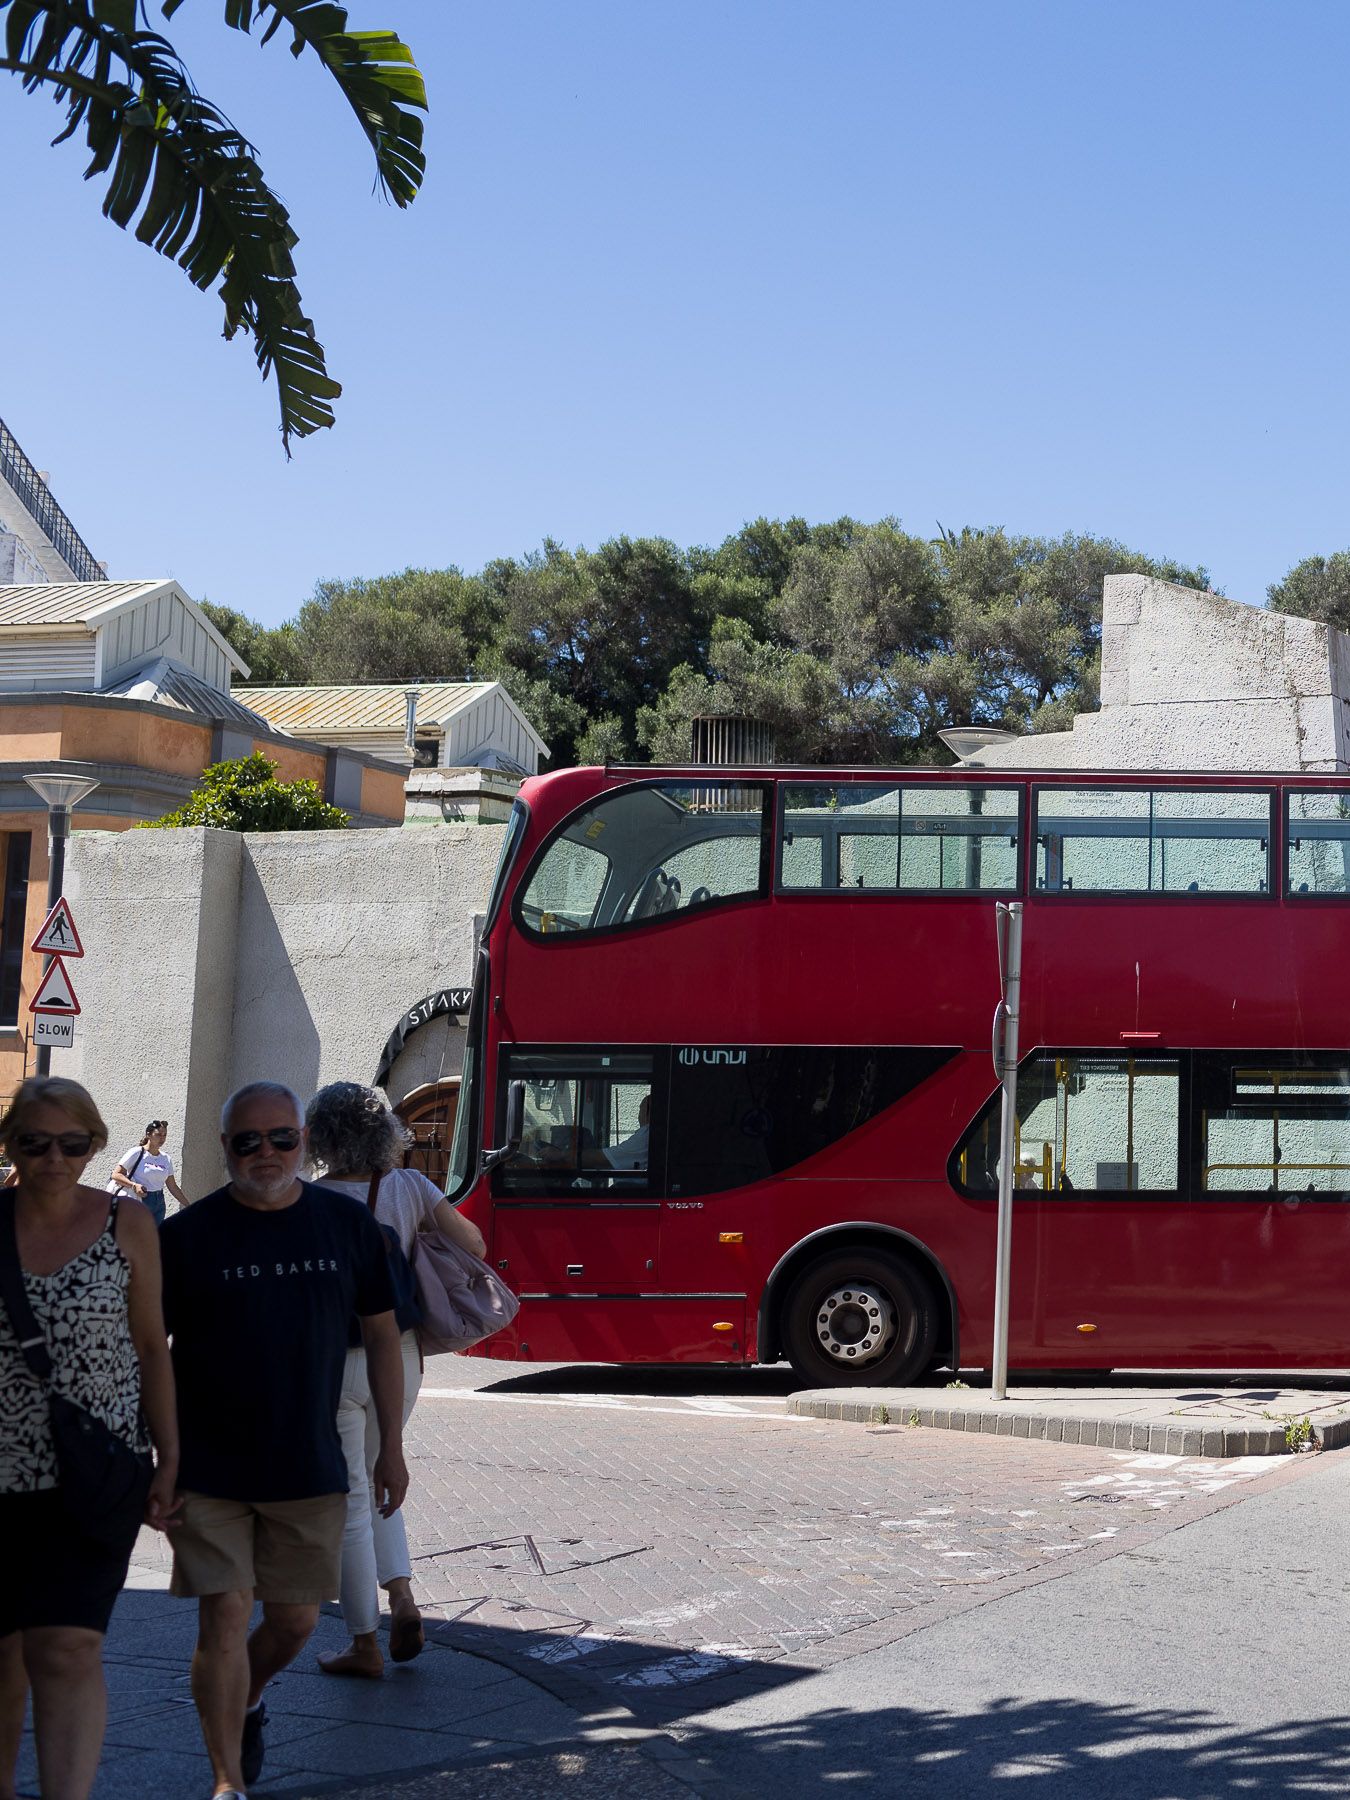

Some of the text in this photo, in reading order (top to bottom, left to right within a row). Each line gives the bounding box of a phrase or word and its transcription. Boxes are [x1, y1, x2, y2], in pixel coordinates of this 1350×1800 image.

[37, 1023, 71, 1036] SLOW
[222, 1259, 338, 1280] TED BAKER
